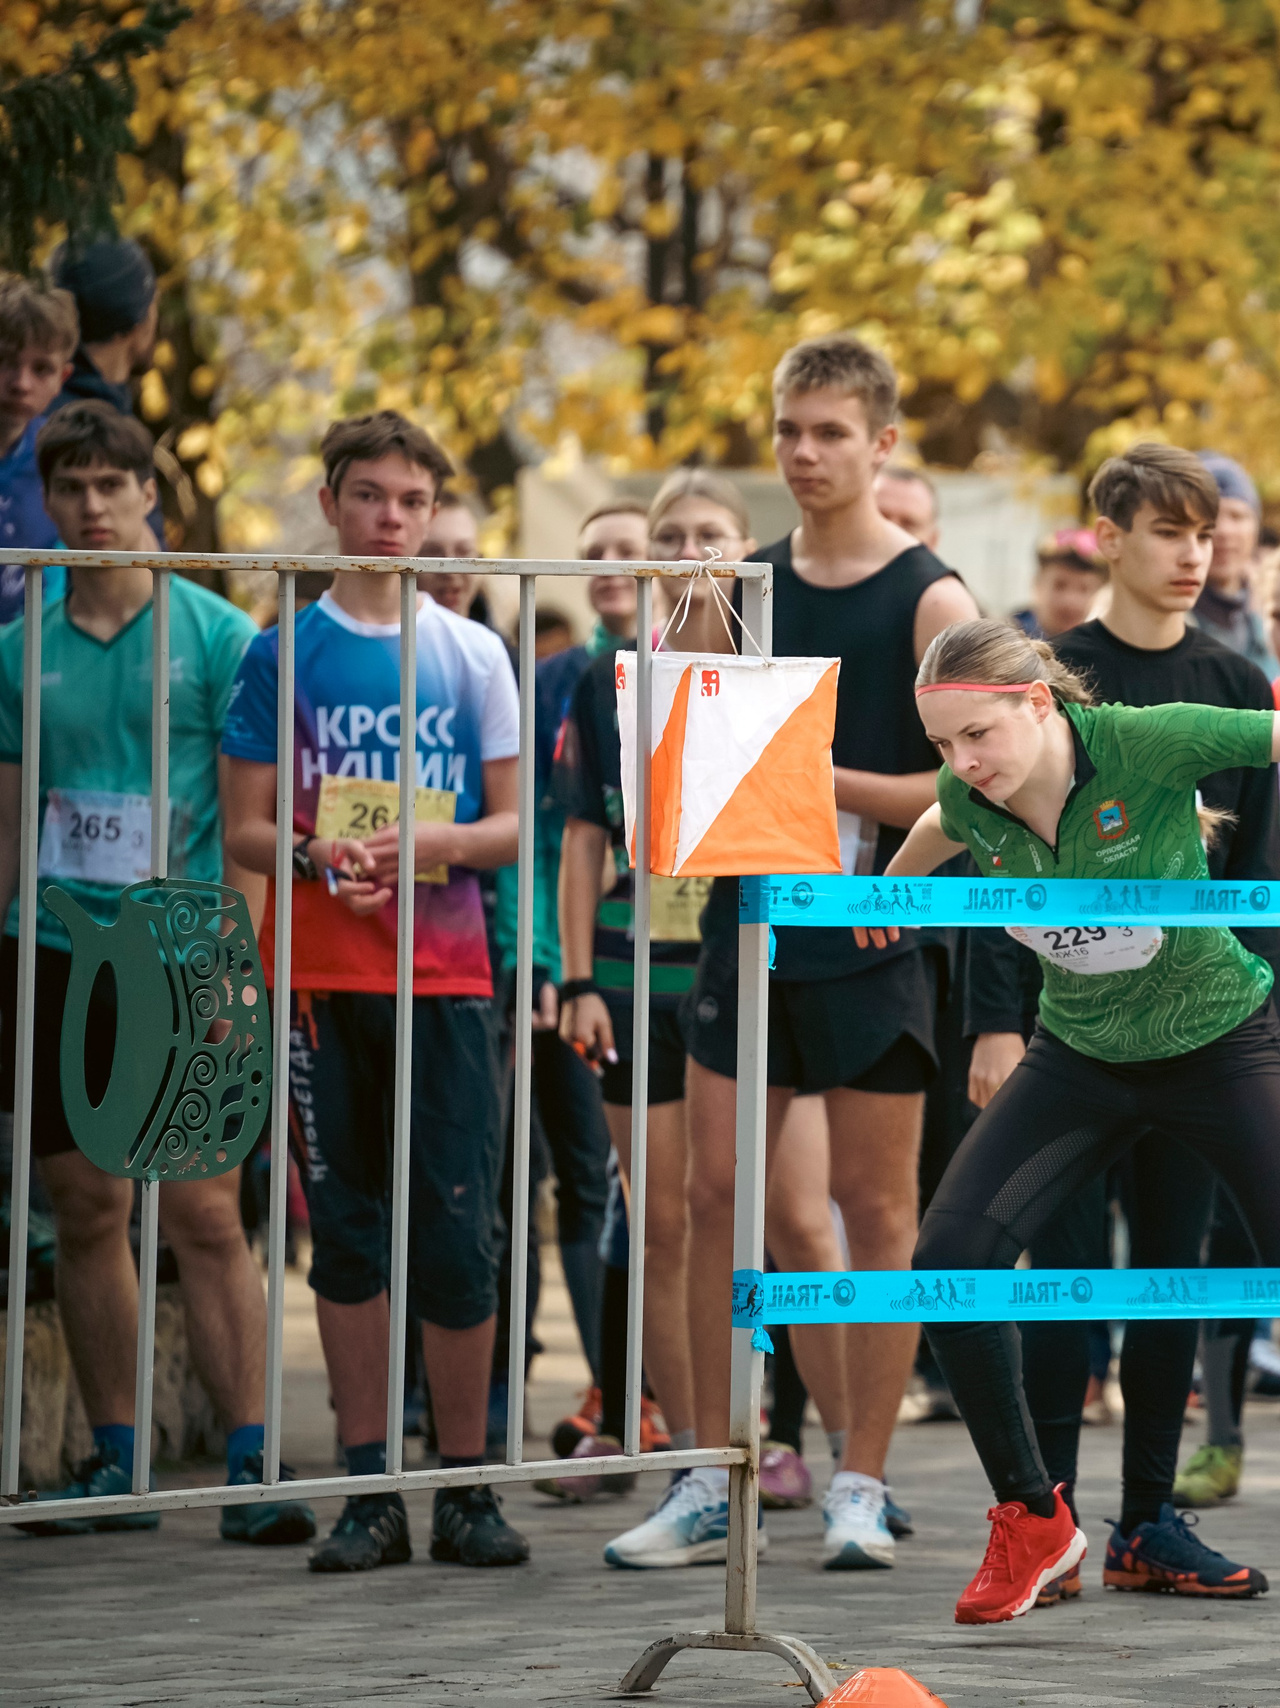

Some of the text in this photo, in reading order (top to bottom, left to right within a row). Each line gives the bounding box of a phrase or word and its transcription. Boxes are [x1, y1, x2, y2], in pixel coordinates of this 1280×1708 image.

[316, 703, 456, 748] КРОСС
[69, 812, 121, 842] 265
[1095, 834, 1141, 858] ОРЛОВСКАЯ
[1103, 846, 1139, 864] ОБЛАСТЬ
[1043, 926, 1107, 951] 229
[1049, 946, 1090, 960] МЖ16
